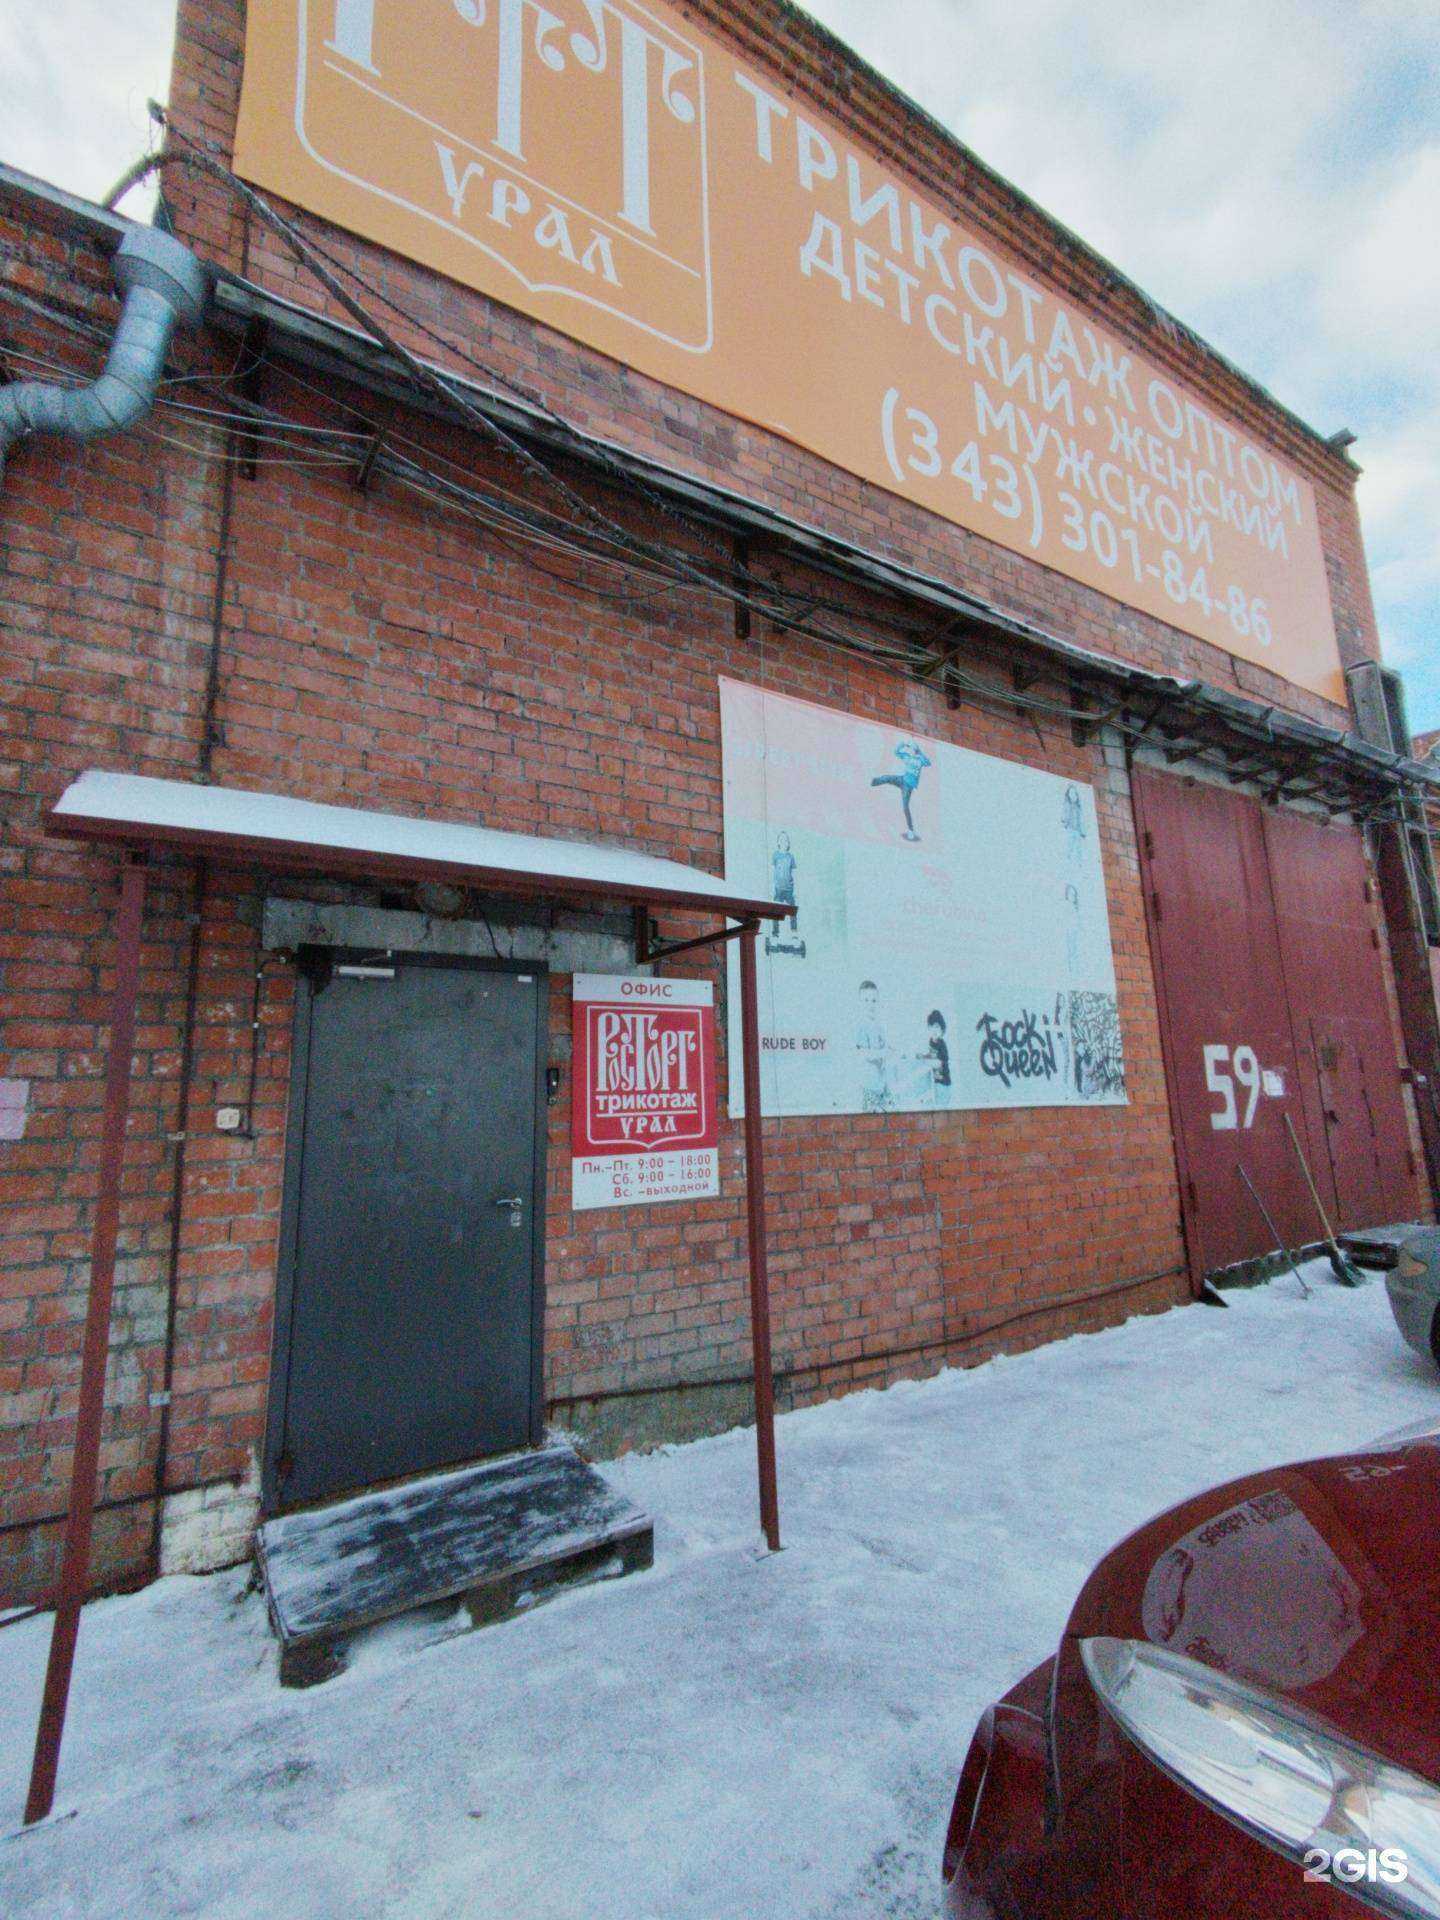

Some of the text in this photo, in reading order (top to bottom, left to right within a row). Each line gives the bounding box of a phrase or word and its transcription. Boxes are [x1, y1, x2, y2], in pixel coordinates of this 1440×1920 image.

[735, 71, 1301, 526] ТРИКОТАЖ ОПТОМ
[801, 210, 1289, 561] ДЕТСКИЙ ЖЕНСКИЙ
[974, 381, 1214, 564] МУЖСКОЙ
[882, 387, 1273, 647] (343) 301-84-86
[621, 982, 672, 997] ОФИС
[762, 1037, 827, 1050] RUDE BOY
[1204, 1045, 1261, 1131] 59
[596, 1092, 697, 1114] трикотаж
[620, 1115, 677, 1139] УРАЛ
[638, 1157, 664, 1169] 9:00
[681, 1154, 711, 1165] 18:00
[612, 1174, 633, 1185] Сб.
[638, 1170, 664, 1182] 9:00
[681, 1168, 711, 1179] 16:00
[613, 1187, 633, 1198] Вс.
